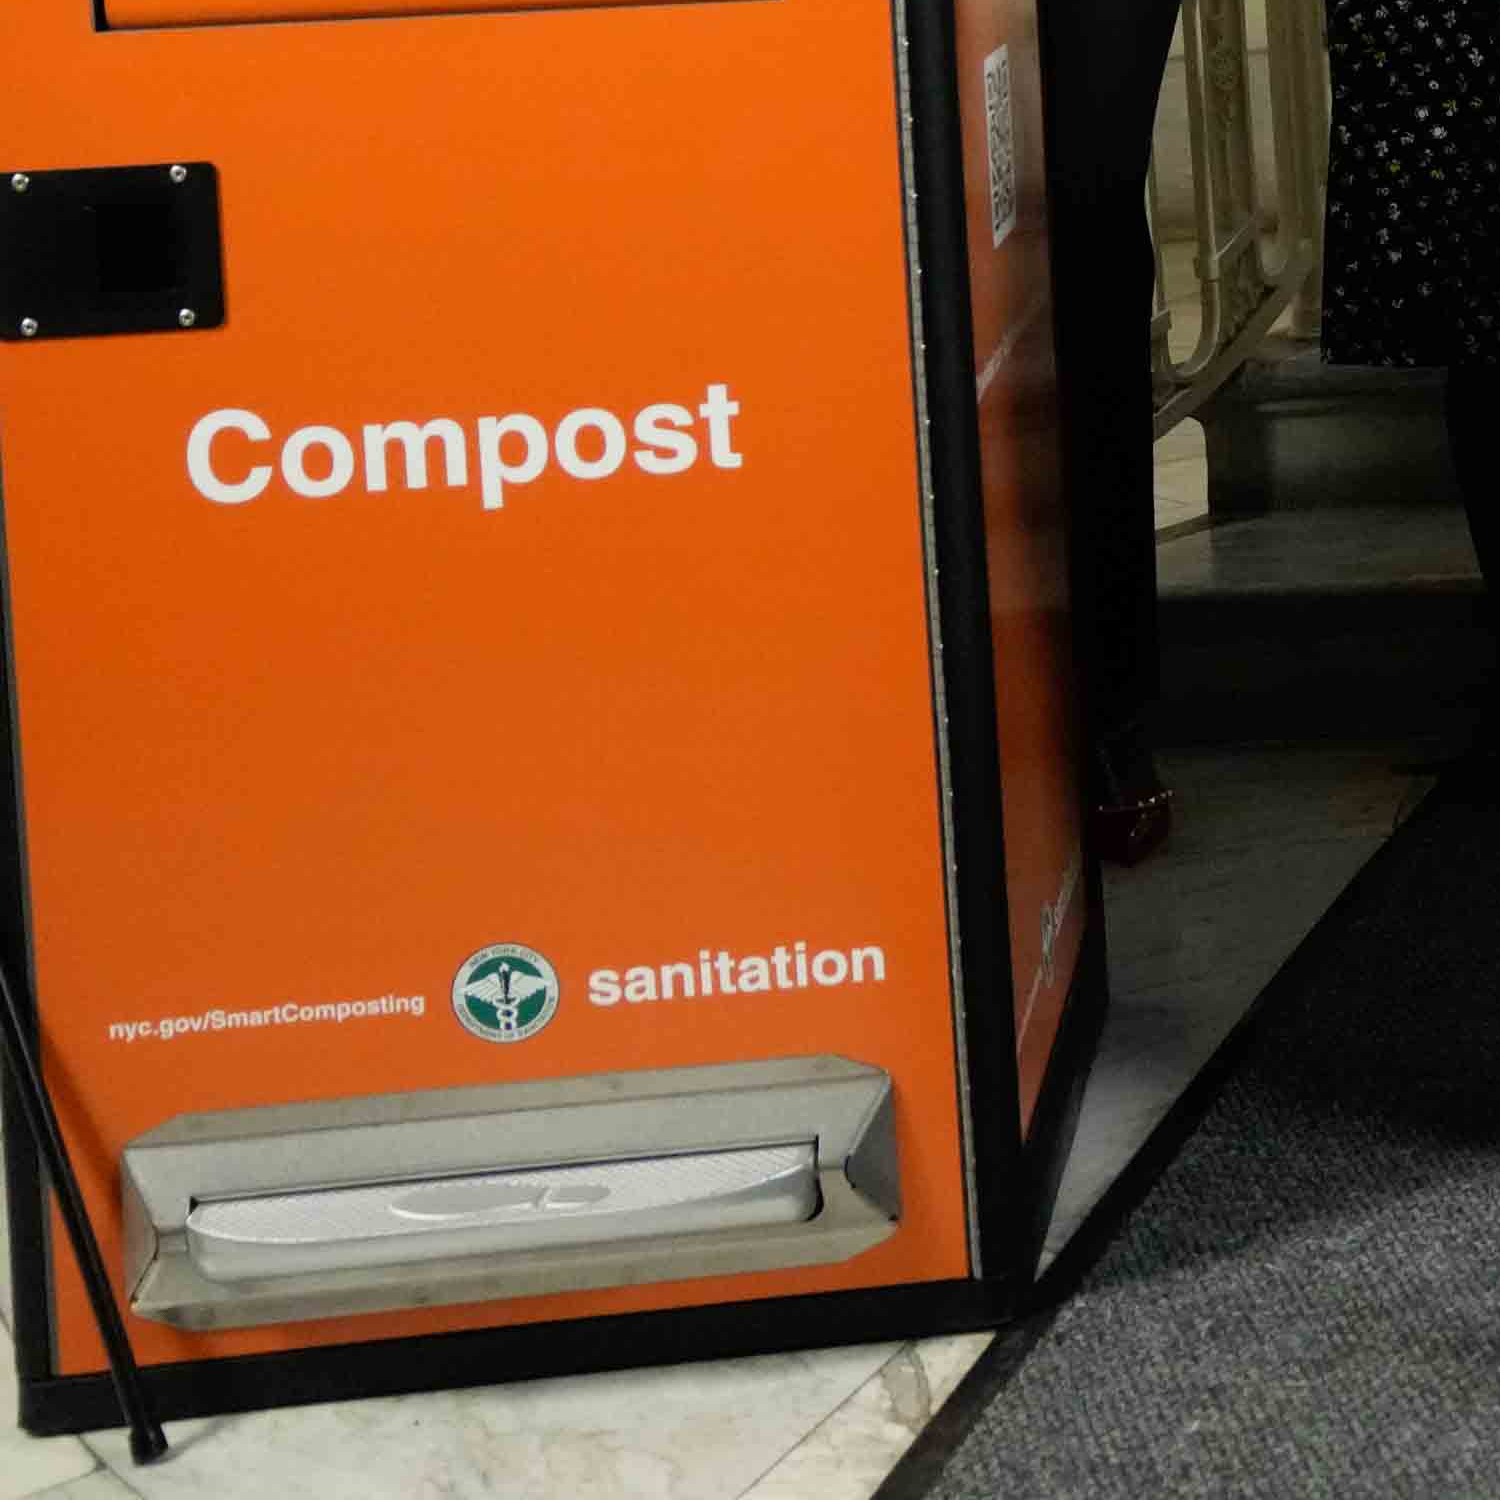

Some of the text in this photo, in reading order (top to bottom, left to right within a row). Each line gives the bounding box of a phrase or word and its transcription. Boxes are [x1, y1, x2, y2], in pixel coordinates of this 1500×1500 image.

[186, 383, 744, 511] Compost
[588, 940, 887, 1006] sanitation
[108, 992, 426, 1041] nyc.gov/SmartComposting
